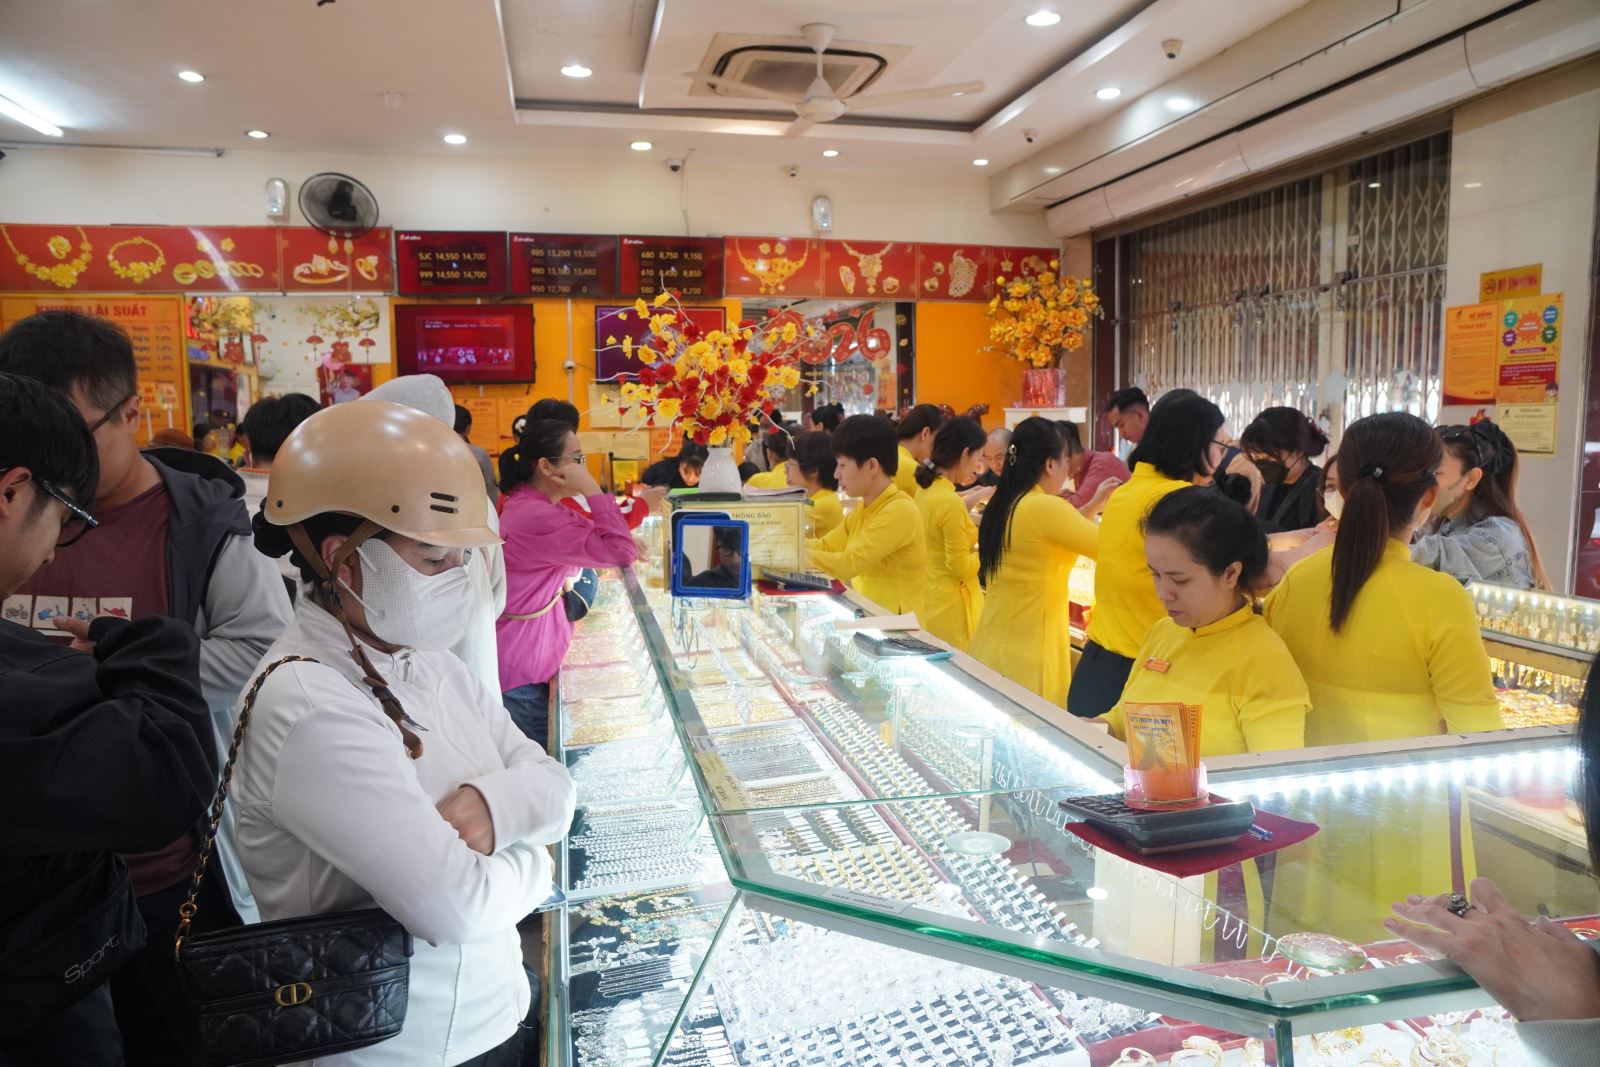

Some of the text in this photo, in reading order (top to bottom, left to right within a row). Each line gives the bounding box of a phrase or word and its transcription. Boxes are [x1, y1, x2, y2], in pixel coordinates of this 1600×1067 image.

[418, 252, 486, 261] SJC 14,550 14,700
[419, 271, 487, 280] 999 14,550 14,700
[64, 934, 119, 984] Sport
